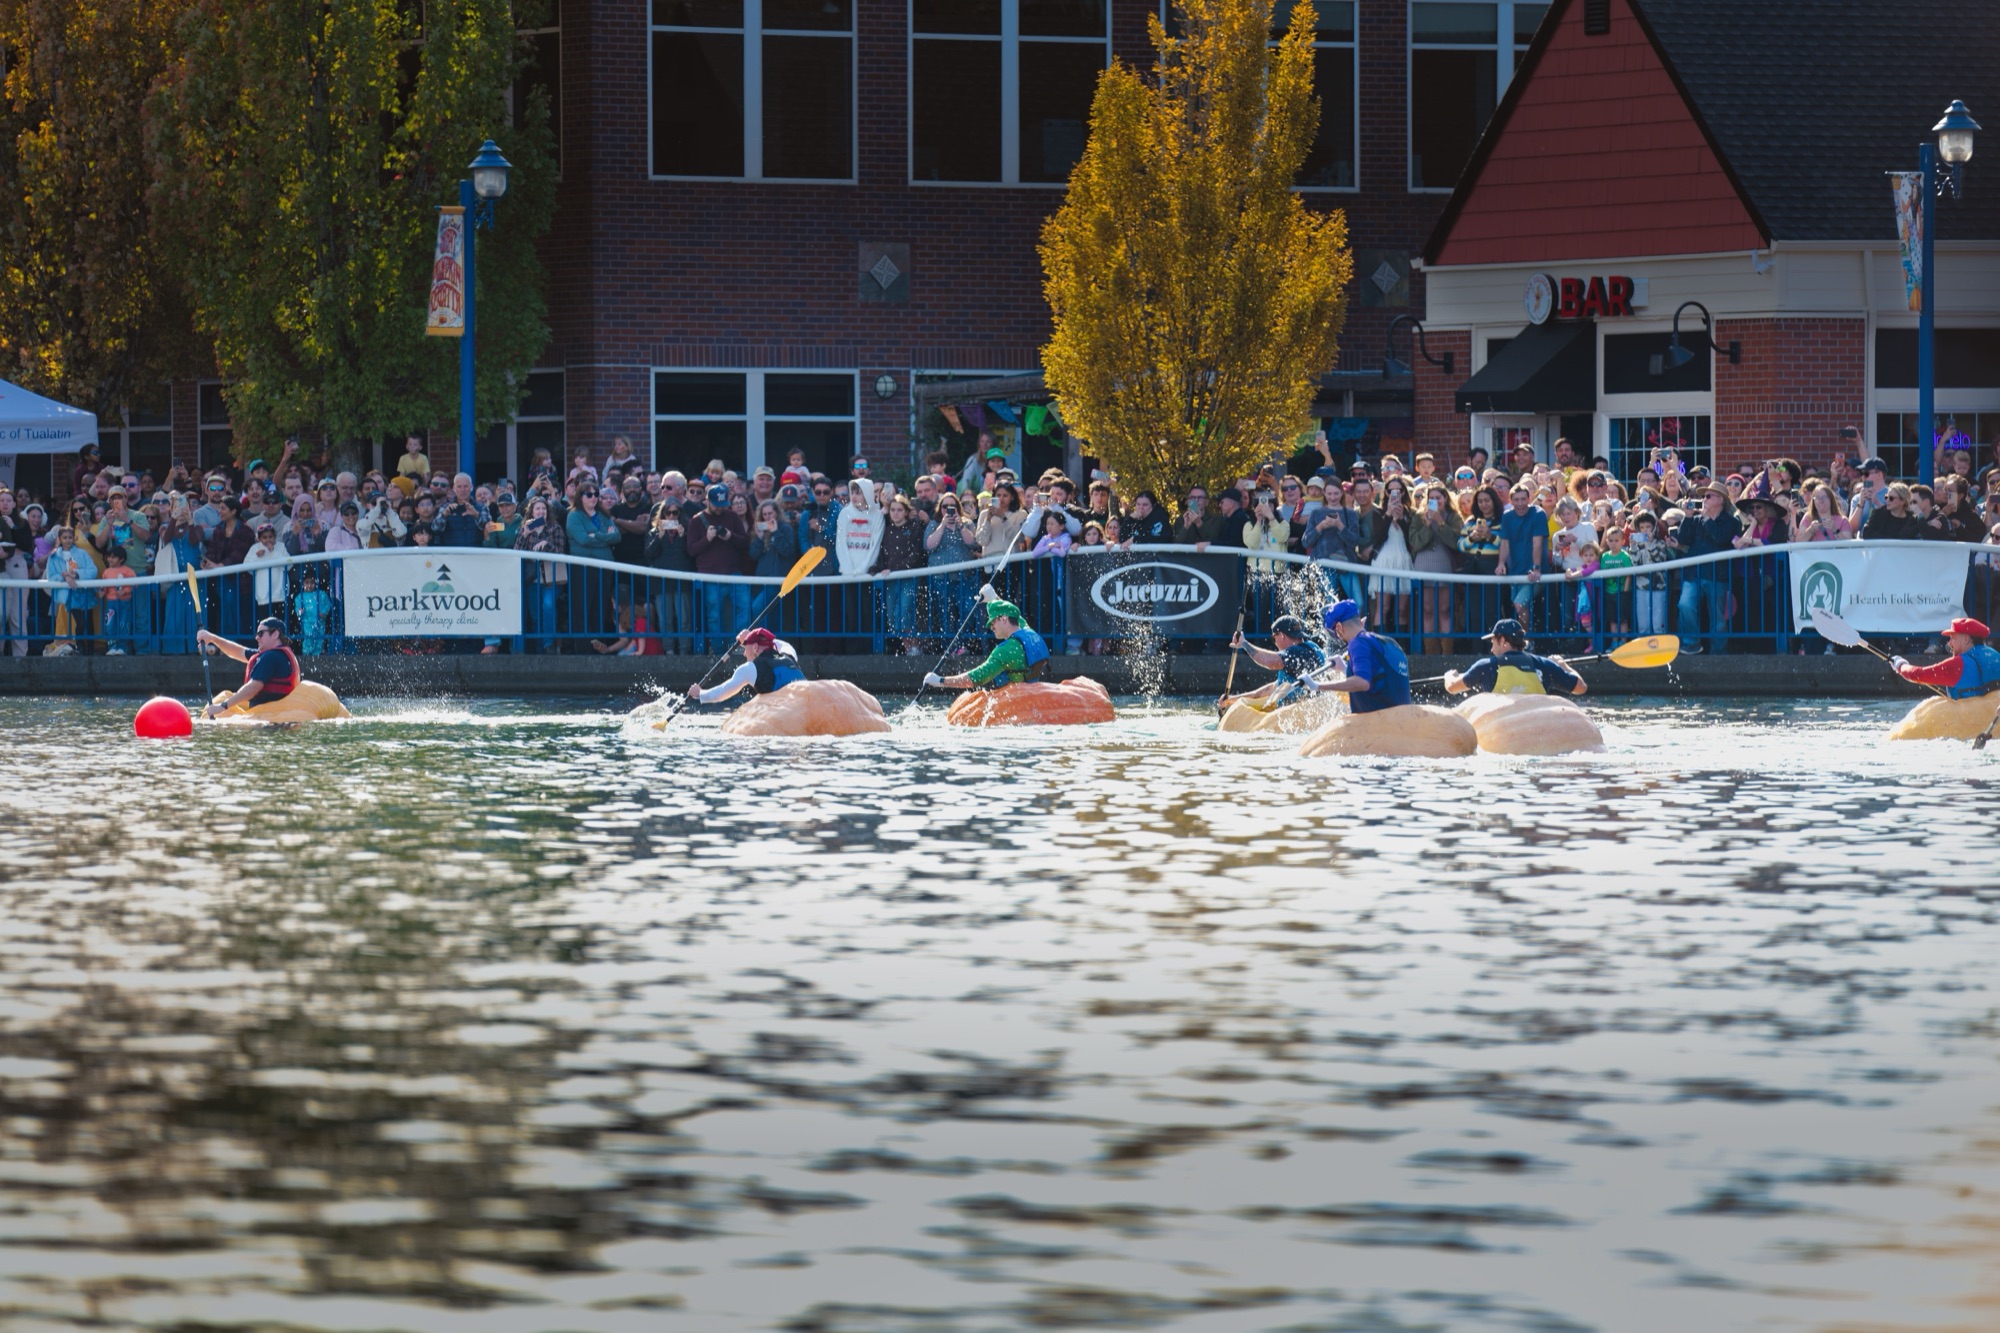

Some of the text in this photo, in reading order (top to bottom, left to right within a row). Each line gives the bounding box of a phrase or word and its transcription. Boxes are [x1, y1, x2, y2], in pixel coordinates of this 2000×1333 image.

[1560, 275, 1633, 318] BAR
[9, 427, 21, 440] of
[24, 428, 71, 440] Tualatin
[366, 588, 501, 618] parkwood
[1107, 578, 1199, 605] Jacuzzi
[1849, 592, 1887, 605] Hearth
[1890, 592, 1913, 605] Folk
[389, 611, 480, 630] specialty therapy clinic
